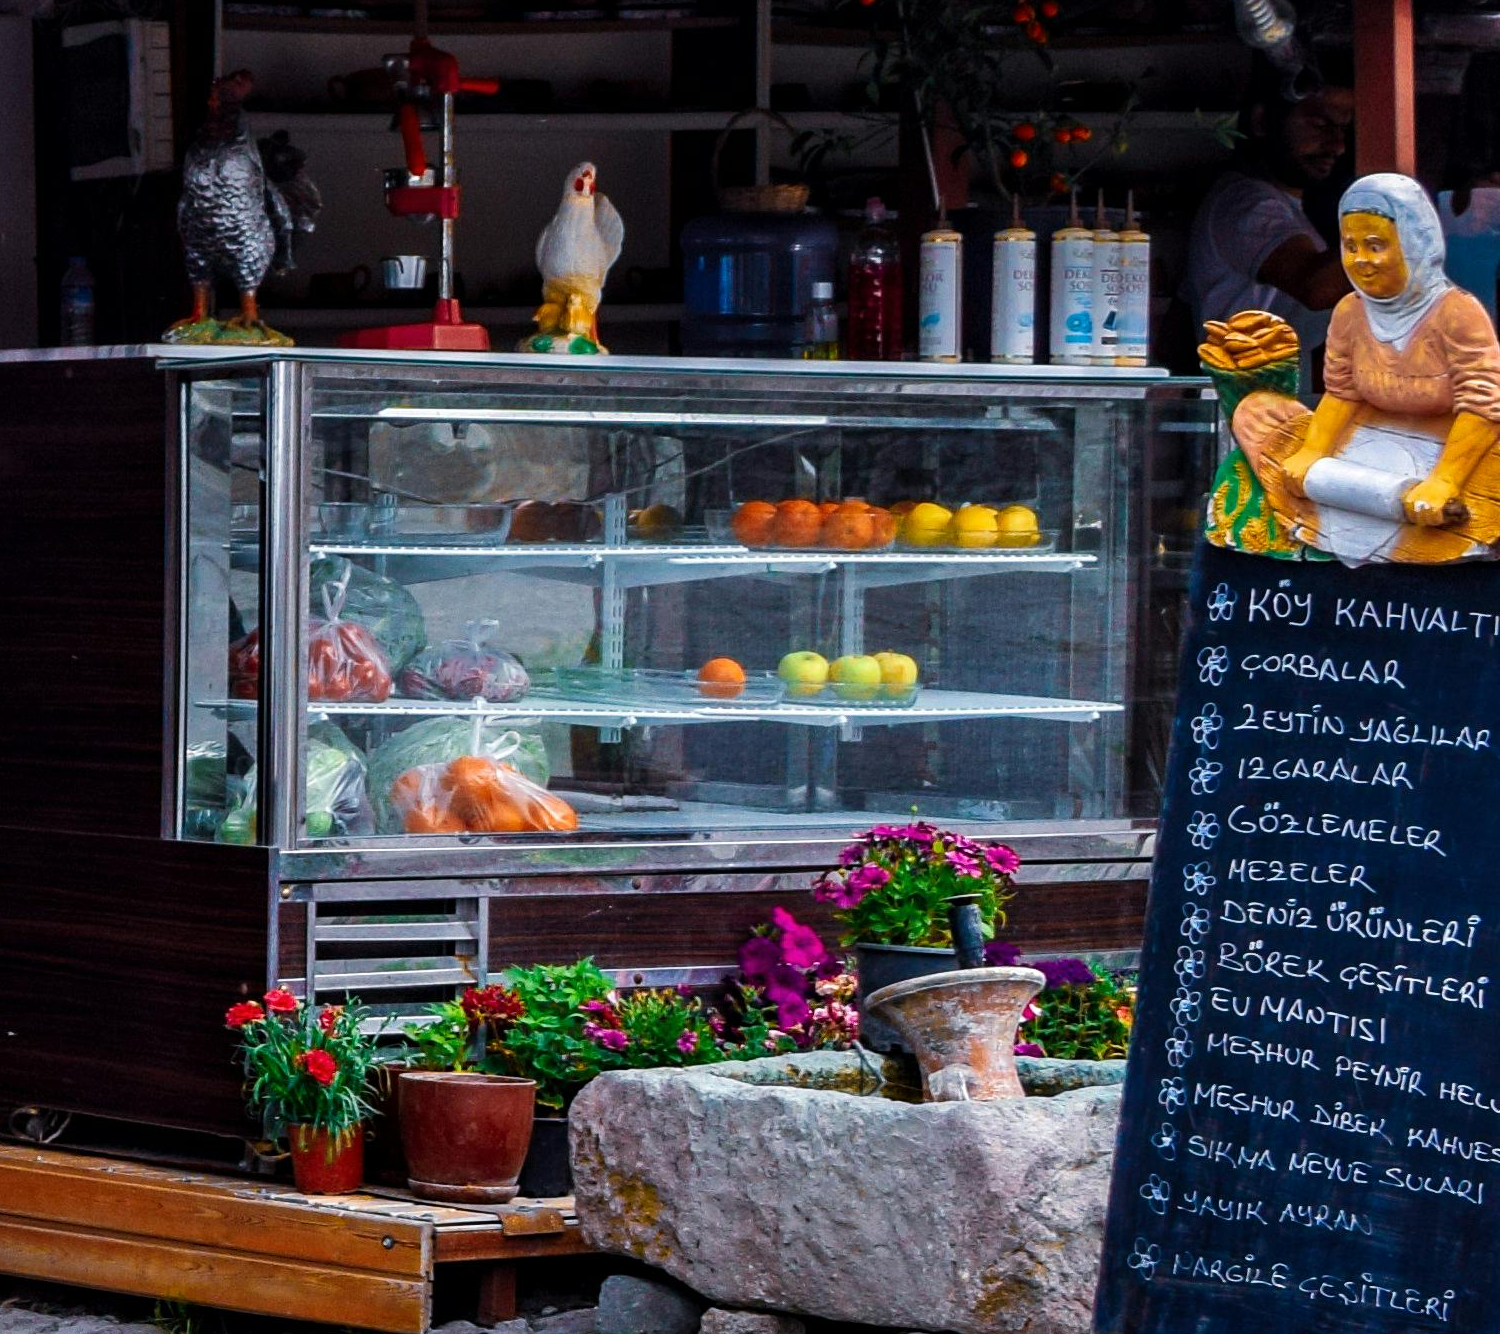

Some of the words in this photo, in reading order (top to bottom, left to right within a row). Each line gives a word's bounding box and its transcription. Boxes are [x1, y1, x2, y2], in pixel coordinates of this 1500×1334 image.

[1248, 579, 1313, 626] KÖY
[1335, 597, 1500, 638] KAHVALTI
[1241, 654, 1406, 689] ÇORBALAR
[1233, 703, 1344, 735] ZEYTİN
[1349, 716, 1491, 751] YAĞLILAR
[1238, 756, 1414, 790] IZGARALAR
[1227, 801, 1447, 857] GÖZLEMELER
[1228, 859, 1377, 894] MEZELER
[1219, 898, 1318, 931] DENİZ
[1326, 901, 1481, 948] ÜRÜNLERİ
[1217, 939, 1331, 984] BÖREK
[1339, 962, 1490, 1010] ÇEŞİTLERİ
[1260, 994, 1387, 1045] MANTISI
[1206, 1032, 1321, 1071] MEŞHUR
[1335, 1055, 1427, 1098] PEYNİR
[1194, 1083, 1300, 1124] MEŞHUR
[1310, 1100, 1394, 1147] DİBEK
[1188, 1135, 1277, 1171] SIKMA
[1289, 1151, 1373, 1186] MEYVE
[1379, 1167, 1485, 1205] SULARI
[1177, 1189, 1268, 1225] YAYIK
[1279, 1203, 1373, 1237] AYRAN
[1172, 1253, 1289, 1289] NARGİLE
[1298, 1271, 1456, 1323] ÇEŞİTLERİ
